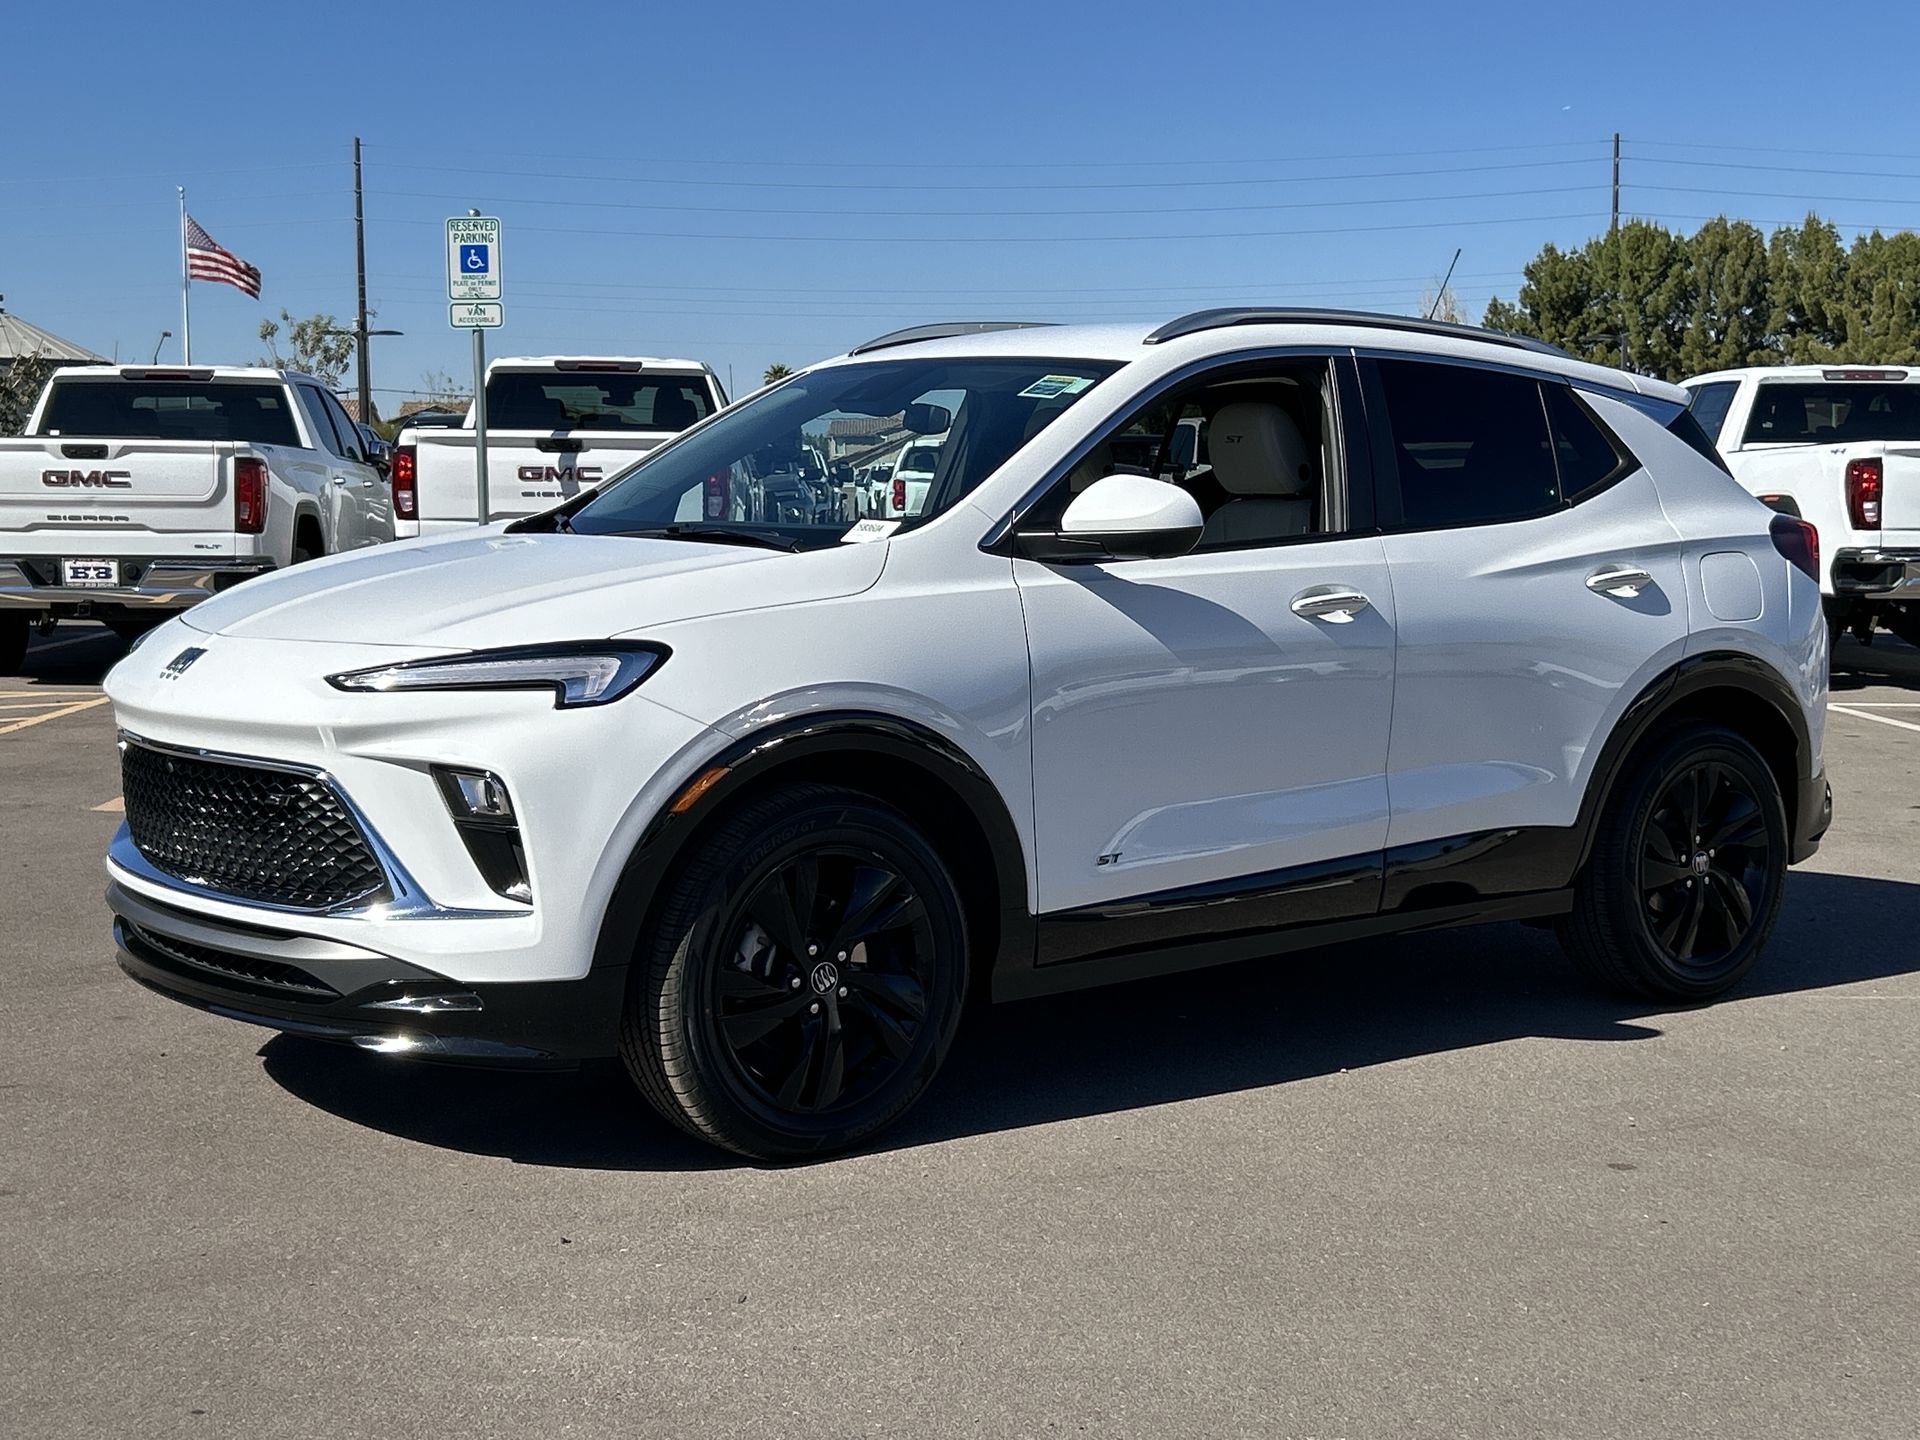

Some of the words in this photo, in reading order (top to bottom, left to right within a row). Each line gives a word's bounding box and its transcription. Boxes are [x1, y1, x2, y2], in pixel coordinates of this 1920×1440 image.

[450, 221, 497, 232] RESERVED
[453, 233, 494, 243] PARKING
[467, 307, 486, 316] VAN
[1225, 435, 1244, 444] ST
[42, 470, 132, 488] GMC
[518, 466, 603, 482] GMC
[1097, 851, 1123, 866] ST
